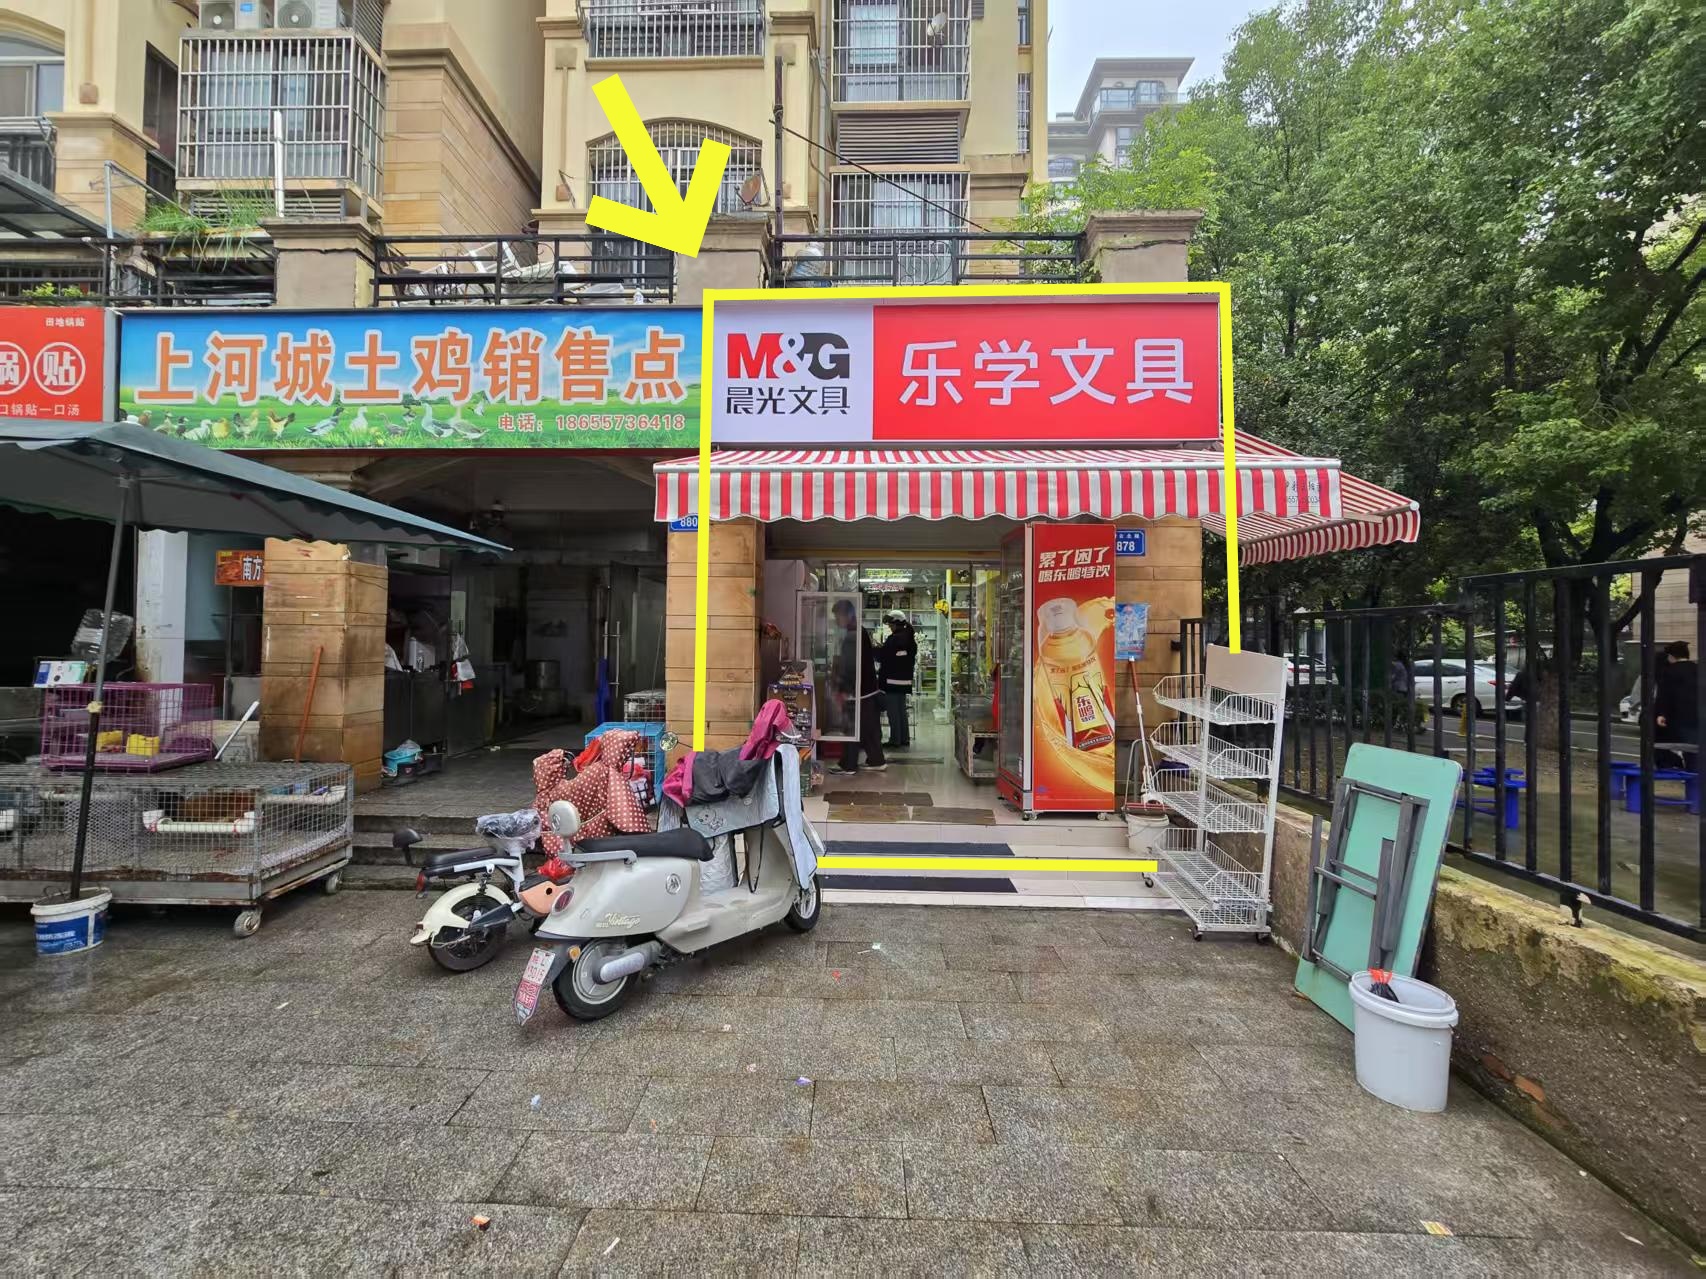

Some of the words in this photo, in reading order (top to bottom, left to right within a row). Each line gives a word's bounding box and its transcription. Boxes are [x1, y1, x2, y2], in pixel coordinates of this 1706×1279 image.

[137, 331, 686, 402] 上河城土鸡销售点
[727, 333, 850, 380] M&G
[899, 338, 1193, 406] 乐学文具
[726, 385, 850, 415] 晨光文具
[556, 415, 685, 430] 18655736418
[1039, 547, 1110, 568] 累了困了
[1116, 541, 1135, 552] 878
[1038, 565, 1111, 582] 喝东鹏特饮
